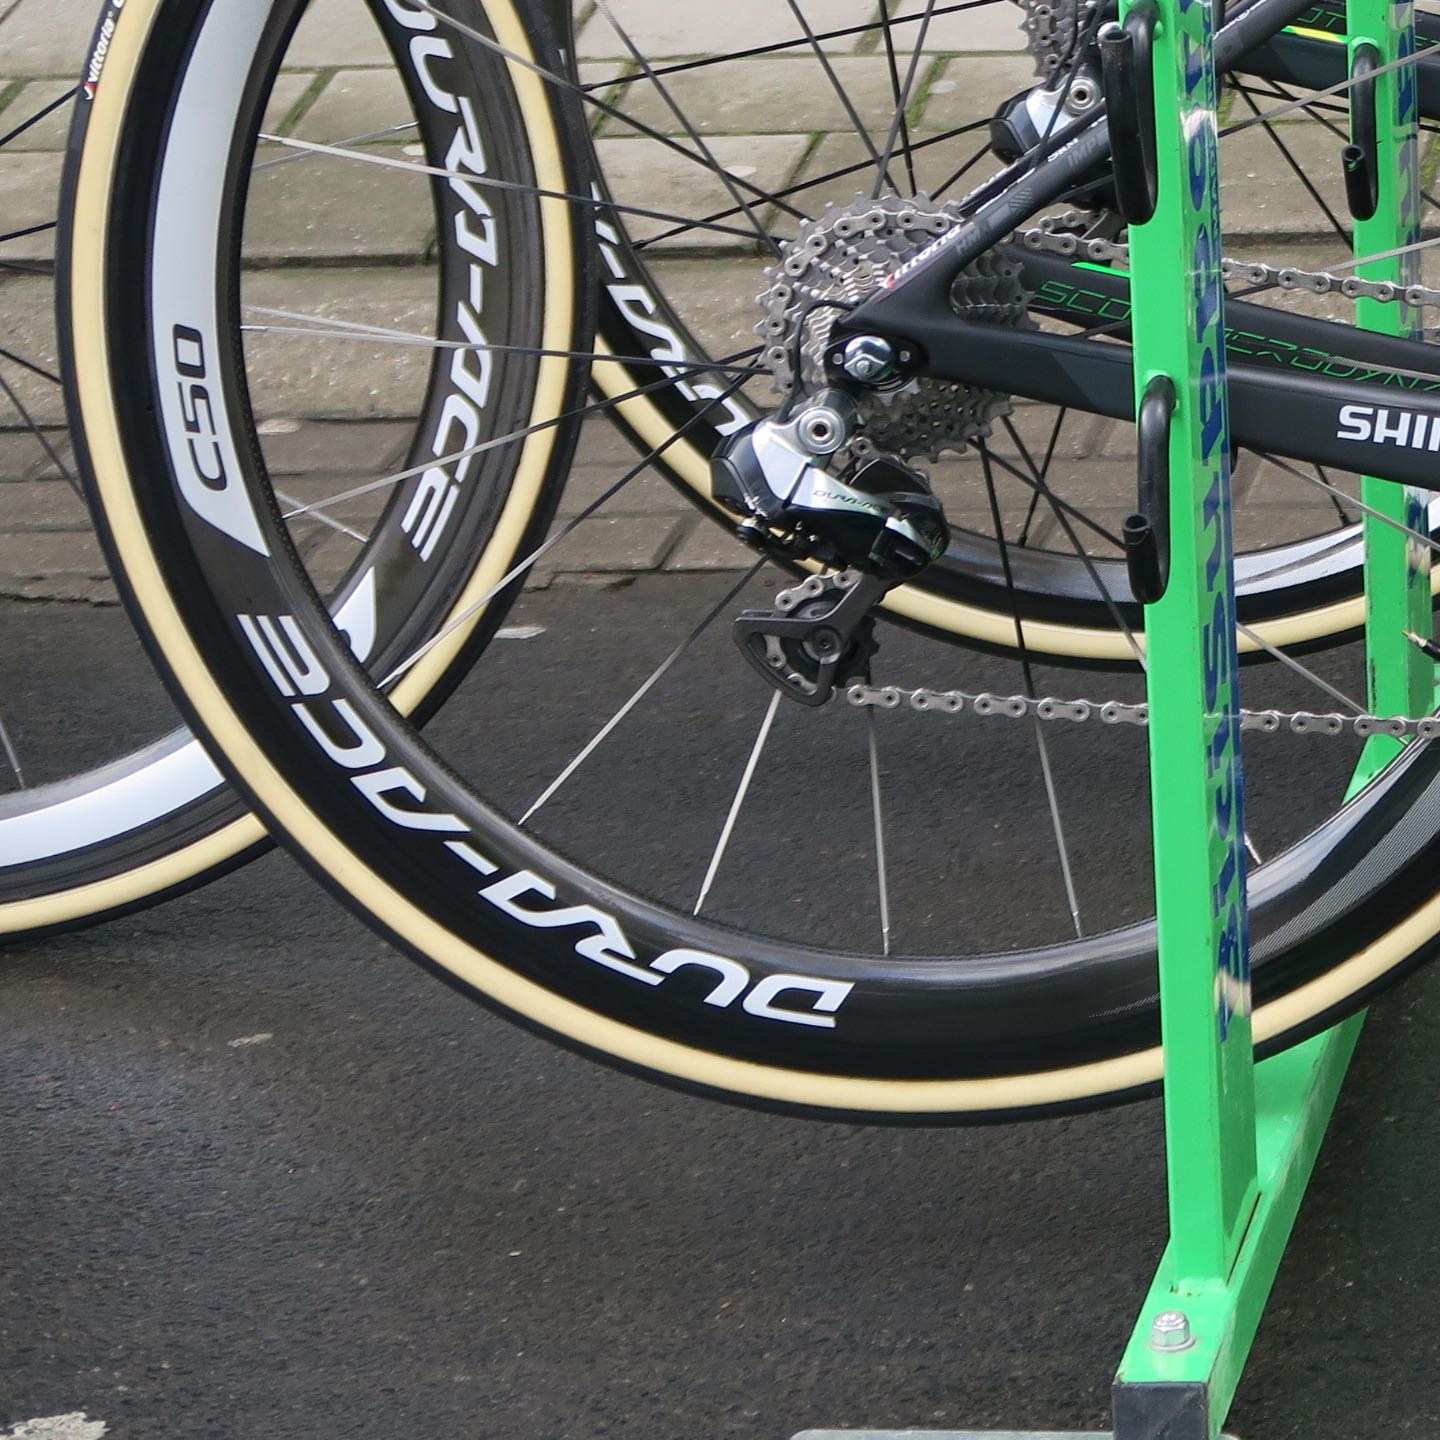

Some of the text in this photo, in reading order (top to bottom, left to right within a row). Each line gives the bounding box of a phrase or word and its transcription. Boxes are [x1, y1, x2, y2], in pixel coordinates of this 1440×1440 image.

[87, 16, 114, 84] vittoria
[1034, 279, 1132, 321] SCO
[170, 322, 230, 491] C50
[238, 612, 858, 1030] DURA-ACE
